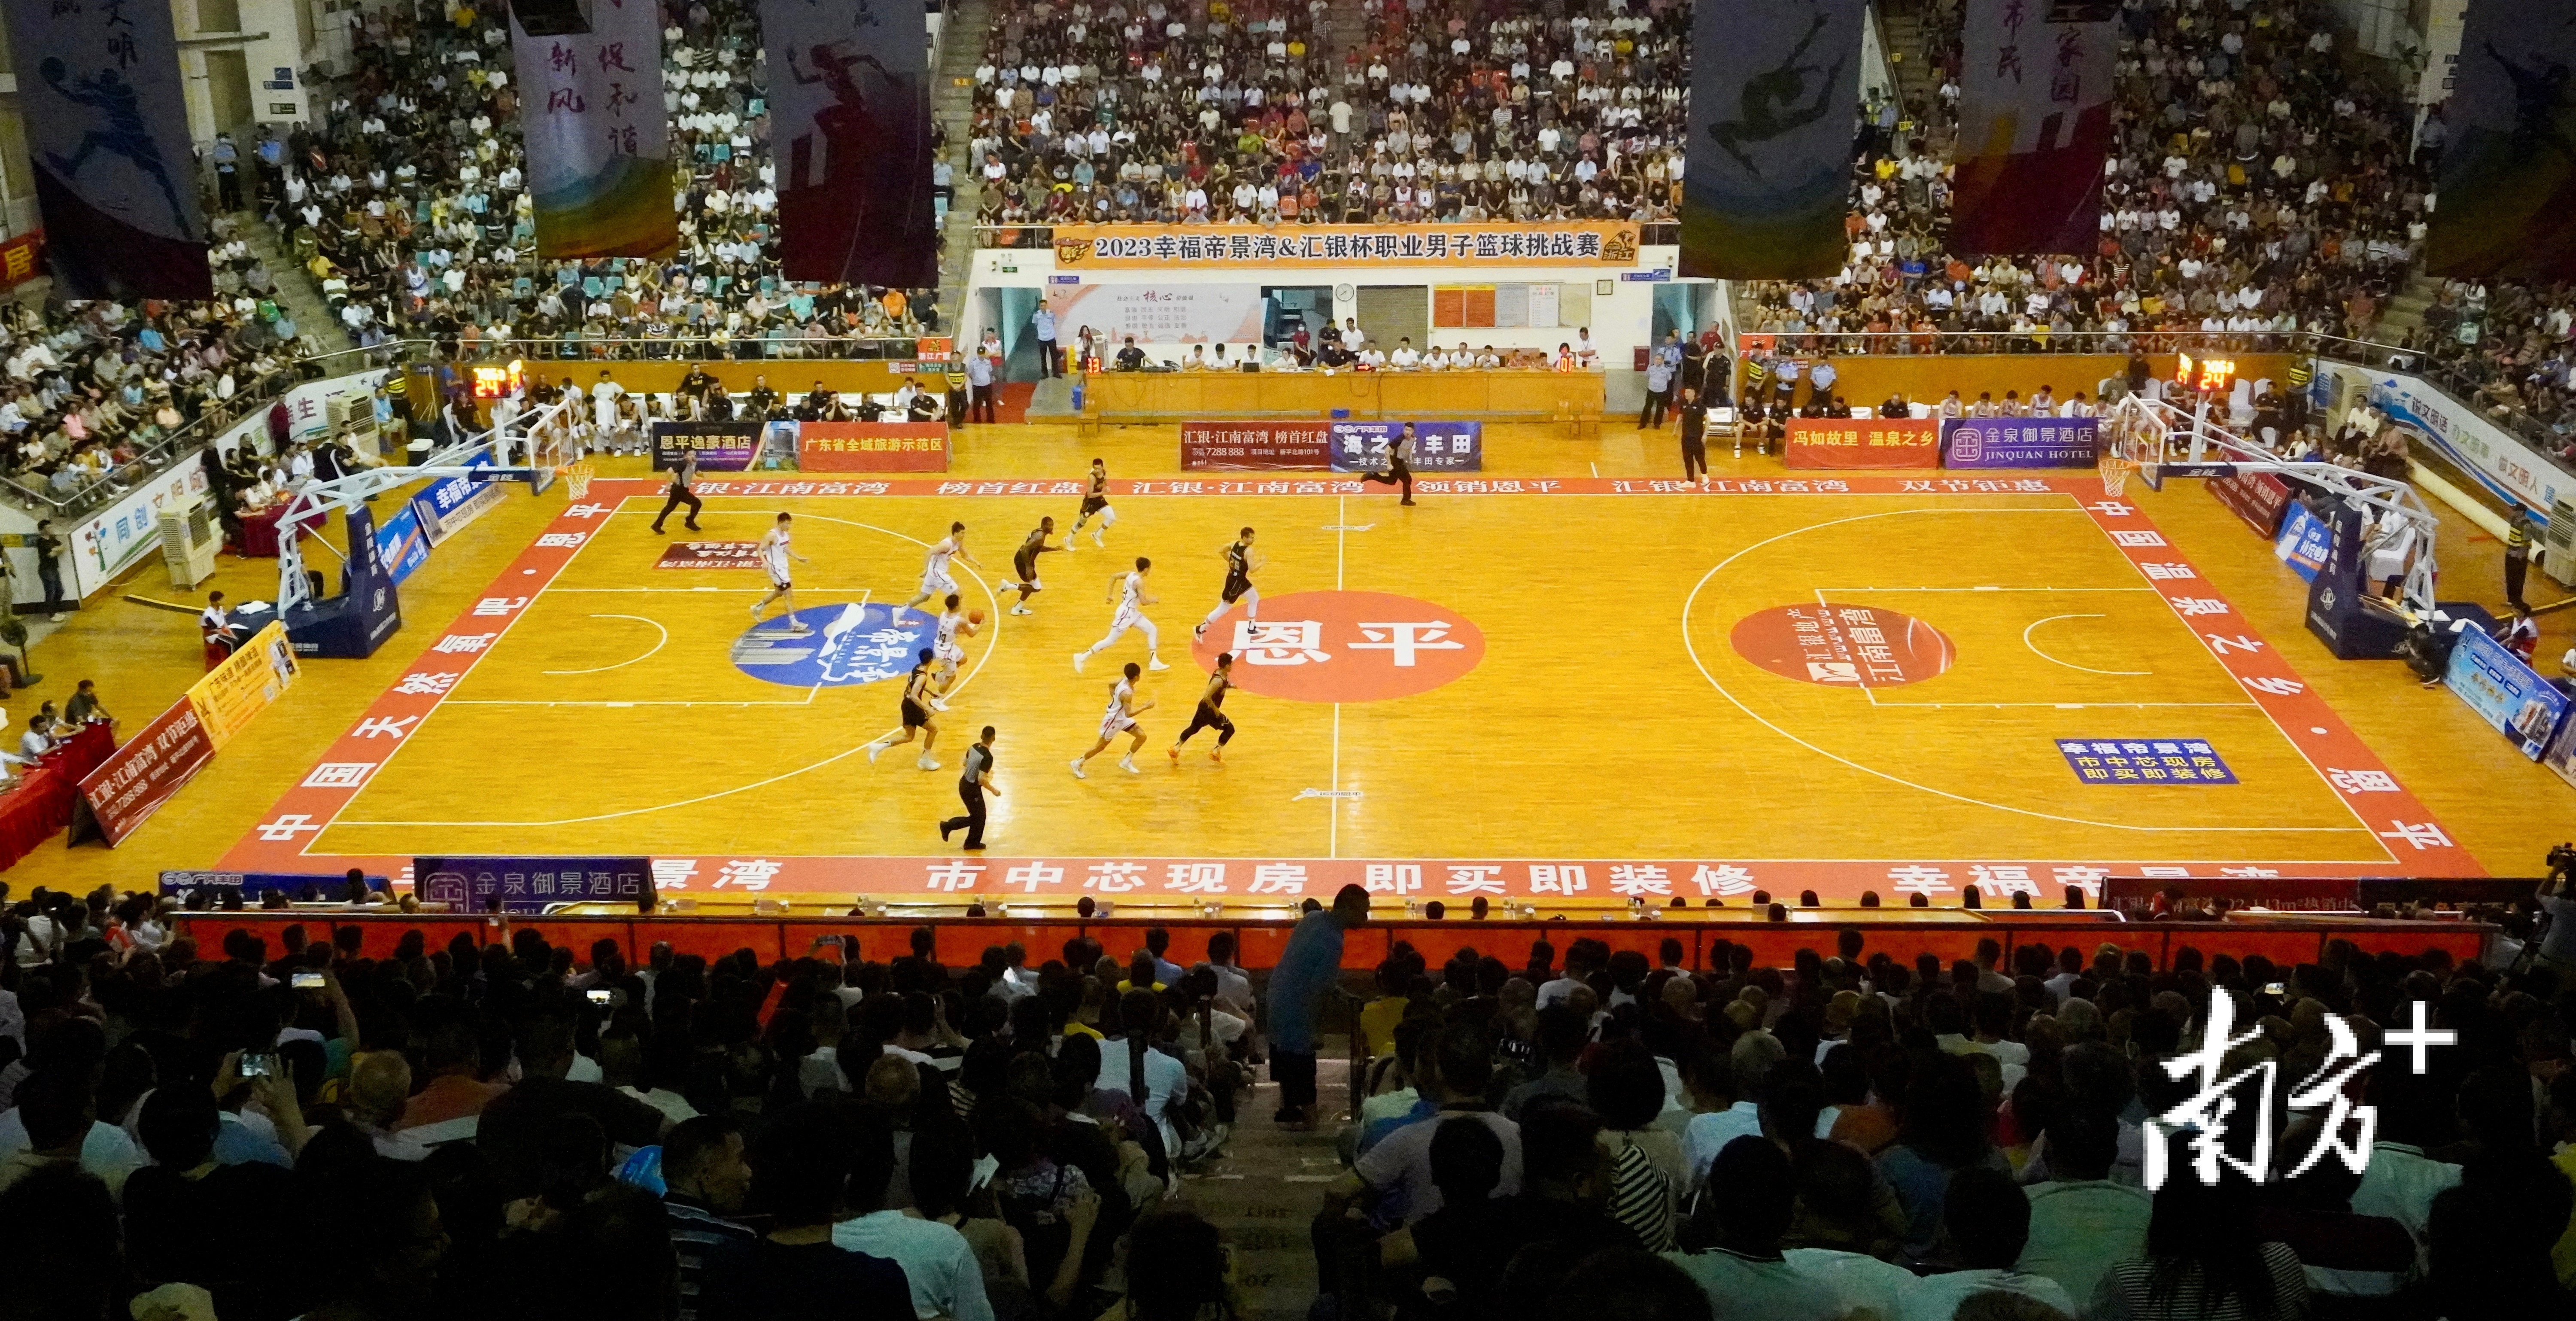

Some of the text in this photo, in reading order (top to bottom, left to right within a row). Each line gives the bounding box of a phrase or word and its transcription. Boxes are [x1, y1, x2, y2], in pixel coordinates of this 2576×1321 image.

[1096, 234, 1600, 259] 2023幸福帝景湾&汇银杯职业男子篮球挑战赛
[1143, 289, 1173, 302] 核心
[476, 380, 498, 396] 24
[2200, 372, 2224, 390] 24
[1184, 430, 1328, 444] 汇银·江南富湾 榜首红盘
[1793, 430, 1934, 447] 冯如故里 温泉之乡
[1985, 426, 2093, 443] 金泉御景酒店
[659, 435, 751, 450] 恩平逸豪酒店
[805, 438, 943, 453] 广东省全域旅游示范区
[1206, 447, 1227, 456] 7288
[1228, 447, 1245, 456] 888
[1985, 450, 2093, 461] JINQUAN HOTEL
[936, 481, 1084, 495] 榜首红盘
[1132, 481, 1365, 494] 汇银·江南富湾
[1416, 480, 1562, 494] 领销恩平
[1215, 620, 1465, 667] 恩平
[1838, 609, 1906, 682] 江南富湾
[2061, 742, 2213, 755] 幸福帝景湾
[2076, 756, 2217, 767] 市中芯现房
[88, 743, 158, 810] 汇银·江南富湾
[2082, 767, 2227, 780] 即买即装修
[476, 871, 641, 895] 金泉御景酒店
[926, 861, 1309, 894] 市中芯现房
[1364, 864, 1759, 897] 即买即装修
